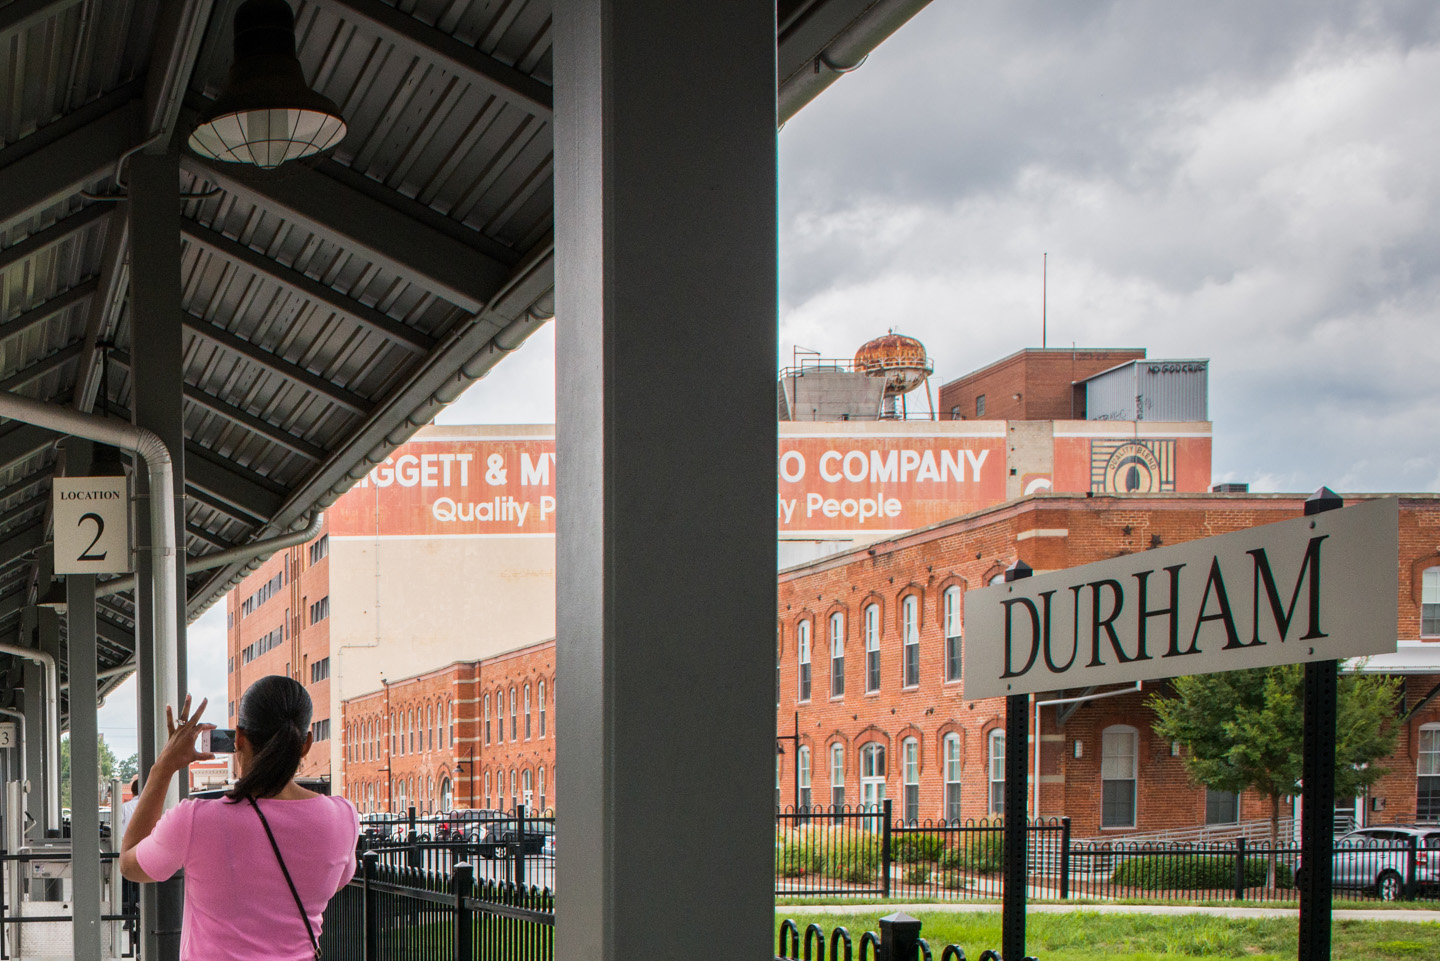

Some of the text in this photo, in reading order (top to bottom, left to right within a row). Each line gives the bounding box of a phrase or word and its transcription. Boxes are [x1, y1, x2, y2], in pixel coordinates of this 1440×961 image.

[349, 454, 473, 488] GGETT
[484, 453, 508, 487] &
[819, 449, 990, 483] COMPANY
[1109, 445, 1157, 470] QUALITY BLEND
[61, 491, 120, 500] LOCATION
[432, 496, 530, 527] Quality
[806, 492, 902, 523] People
[77, 512, 107, 562] 2
[999, 534, 1330, 680] DURHAM
[1, 731, 9, 745] 3
